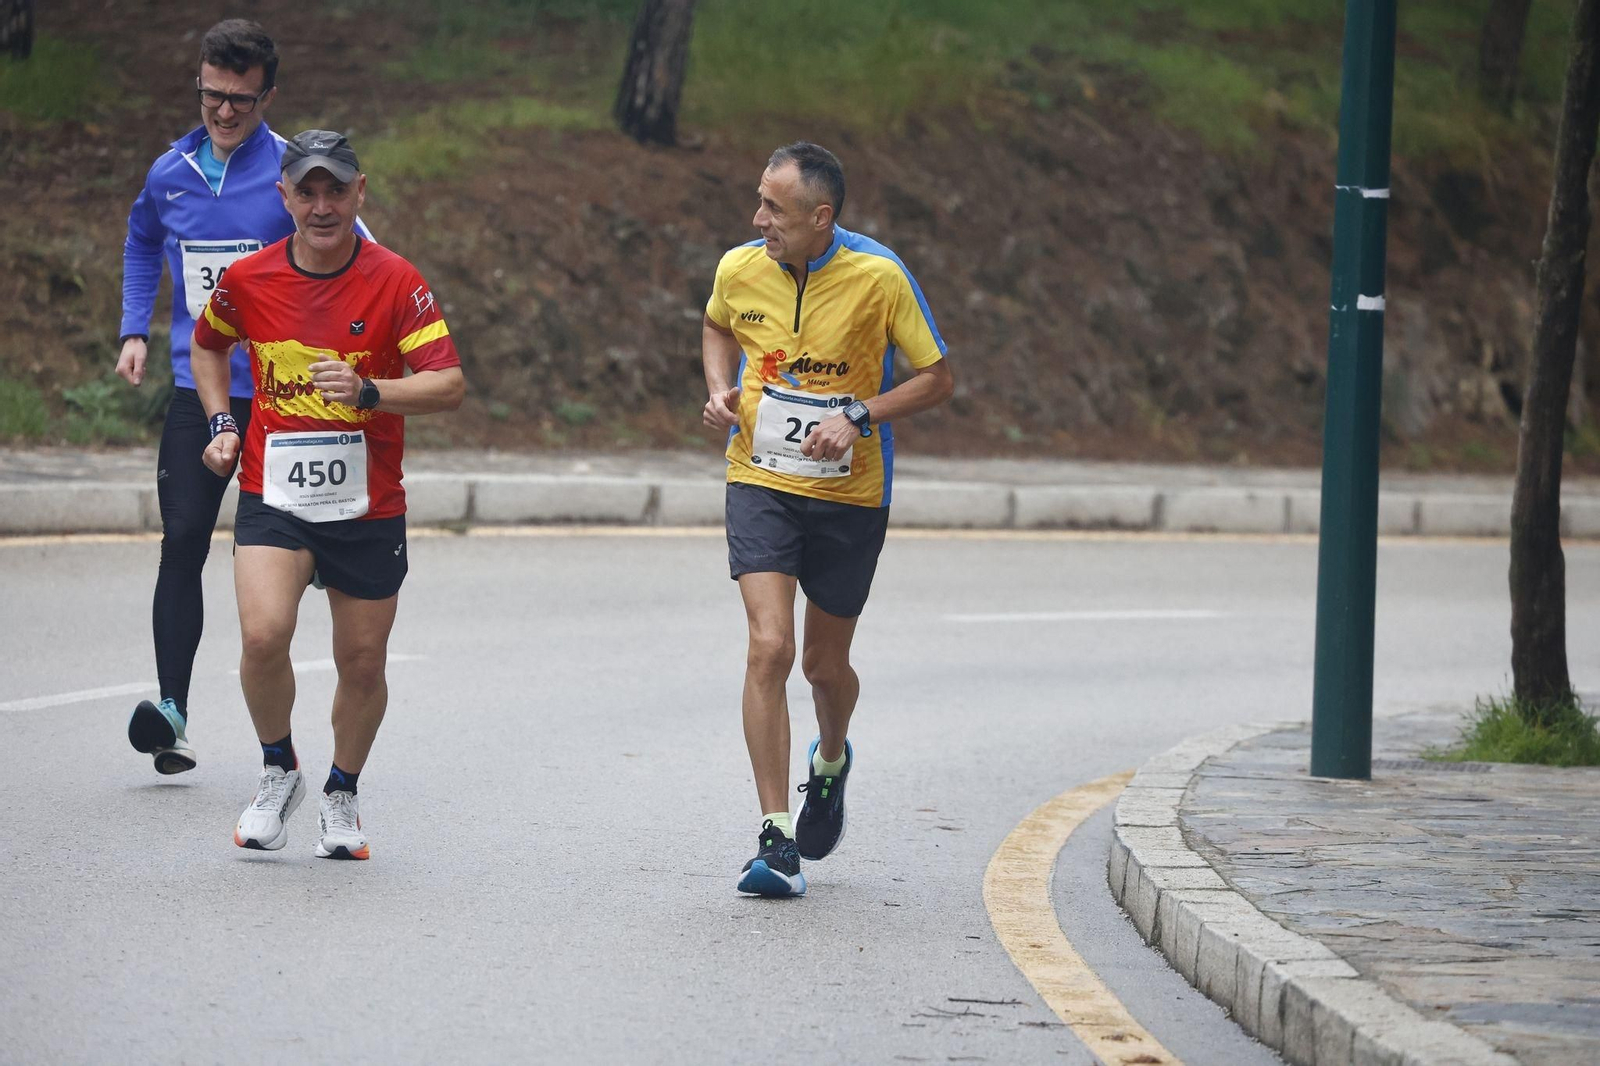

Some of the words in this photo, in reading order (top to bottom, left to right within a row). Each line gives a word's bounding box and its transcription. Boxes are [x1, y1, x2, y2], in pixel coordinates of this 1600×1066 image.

[788, 352, 850, 377] Álora
[806, 379, 831, 387] Málaga
[287, 459, 347, 488] 450
